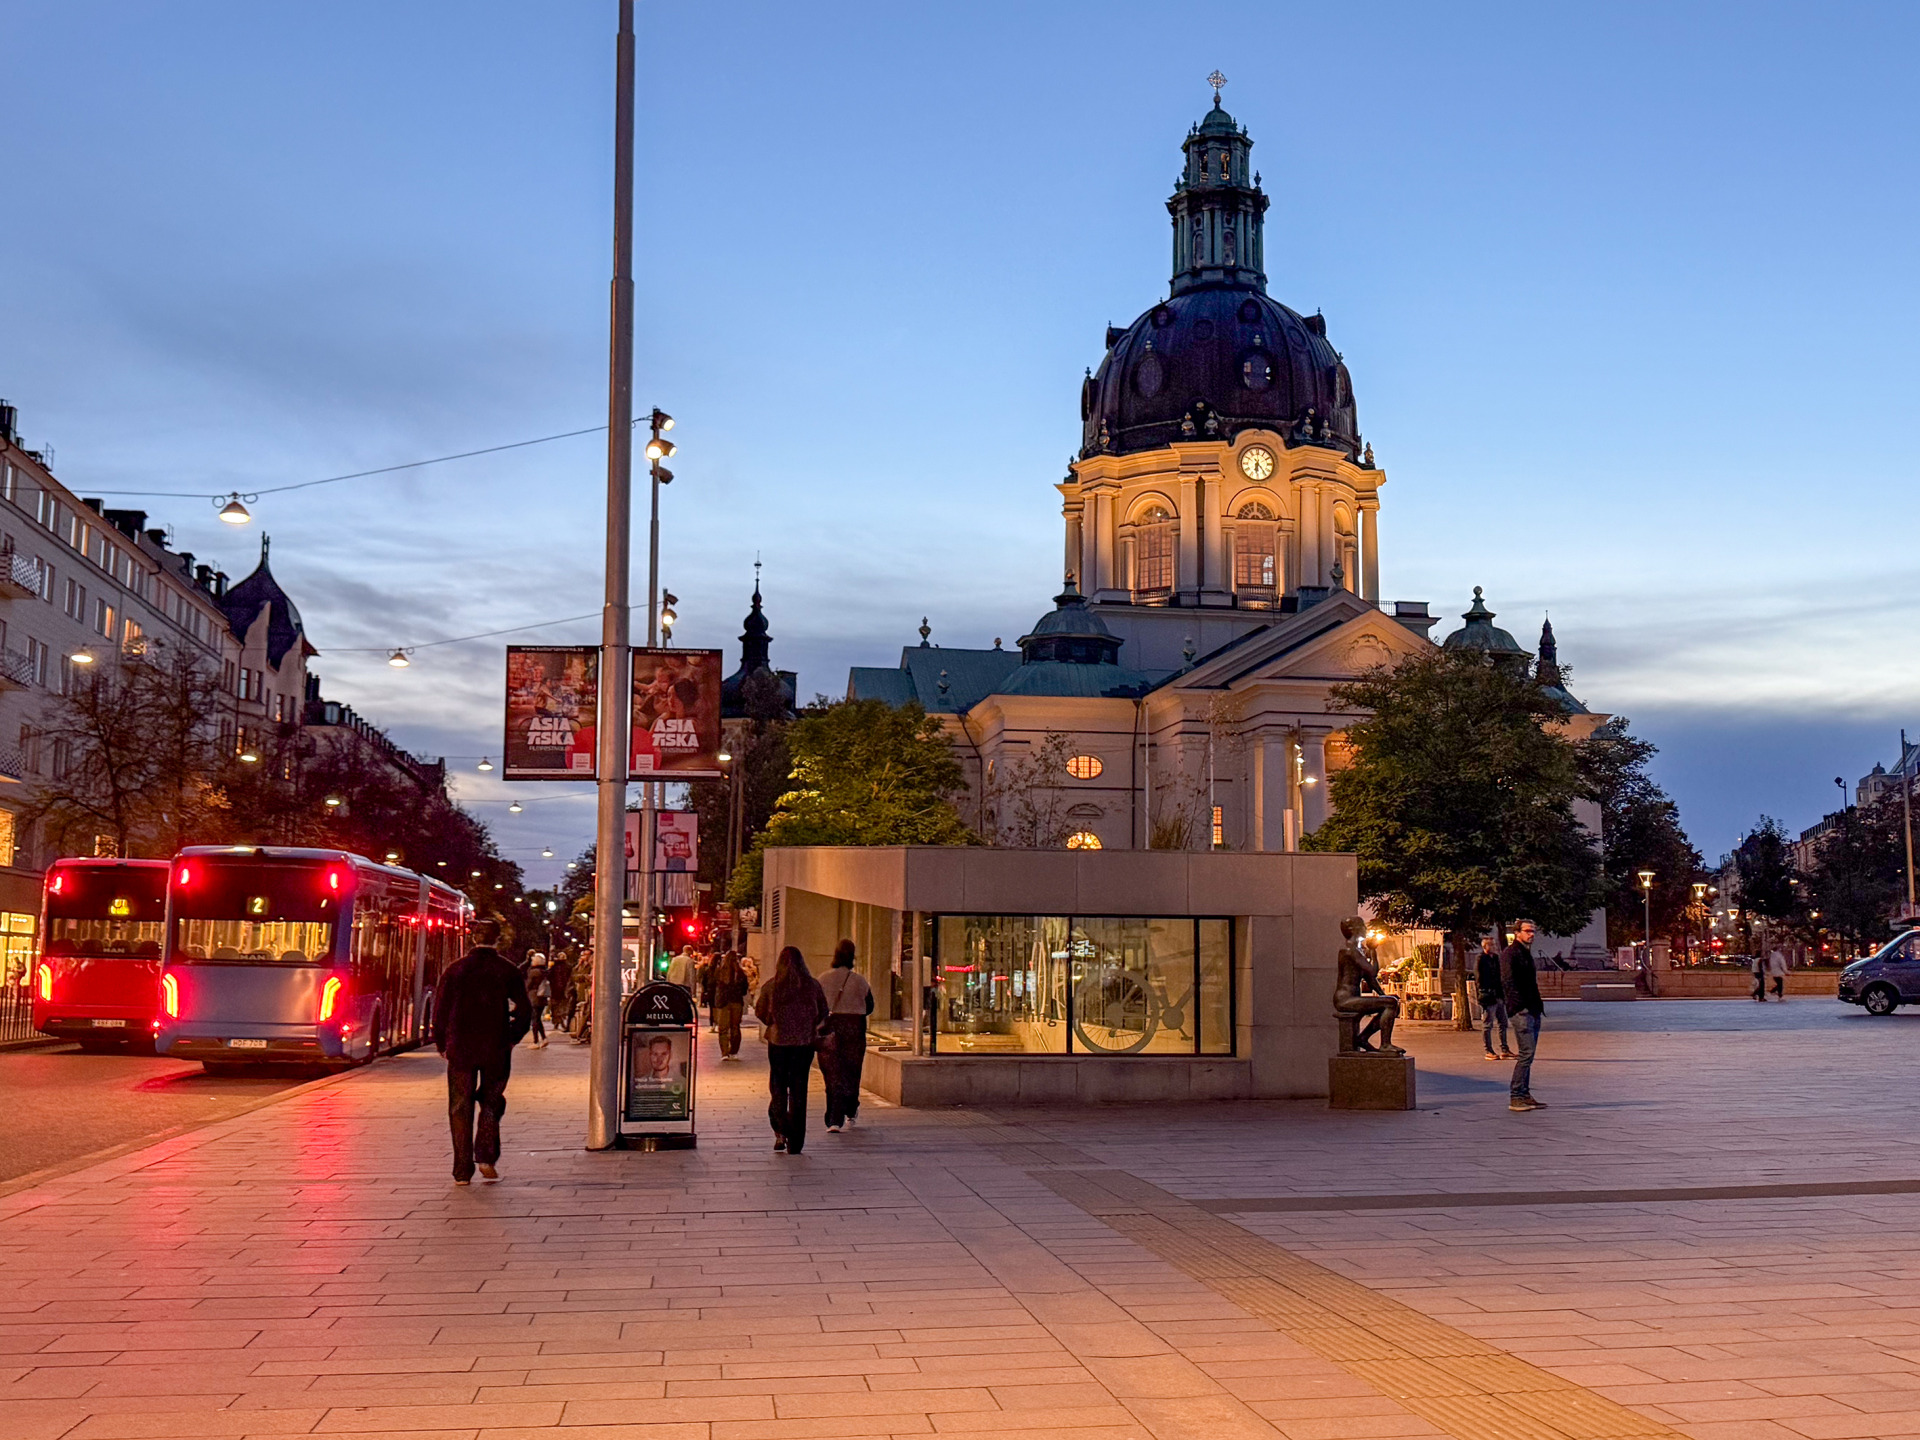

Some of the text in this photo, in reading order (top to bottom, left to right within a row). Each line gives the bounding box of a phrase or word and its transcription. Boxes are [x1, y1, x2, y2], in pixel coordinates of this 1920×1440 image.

[529, 717, 572, 731] ASIA
[653, 719, 696, 733] ASIA
[253, 897, 263, 913] 2
